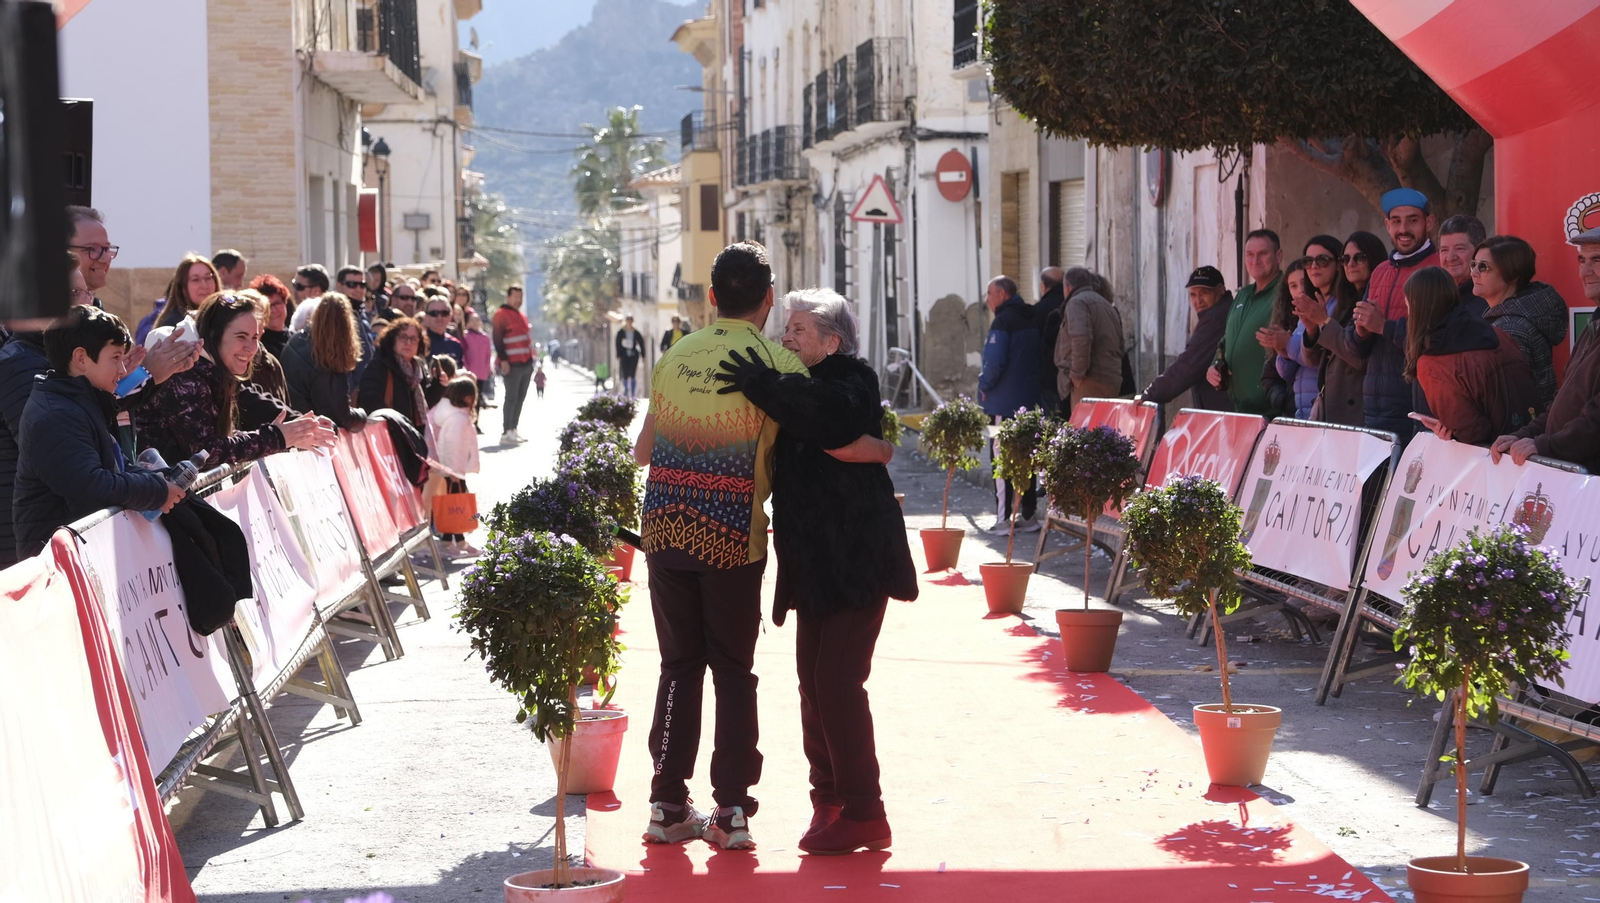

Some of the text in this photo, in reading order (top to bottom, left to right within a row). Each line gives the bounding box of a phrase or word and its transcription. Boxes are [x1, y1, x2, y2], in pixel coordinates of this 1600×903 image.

[678, 363, 702, 382] Pepe
[690, 386, 712, 395] speaker
[1265, 491, 1352, 546] CANTORI
[665, 680, 677, 728] EVENTOS
[661, 731, 669, 751] NON
